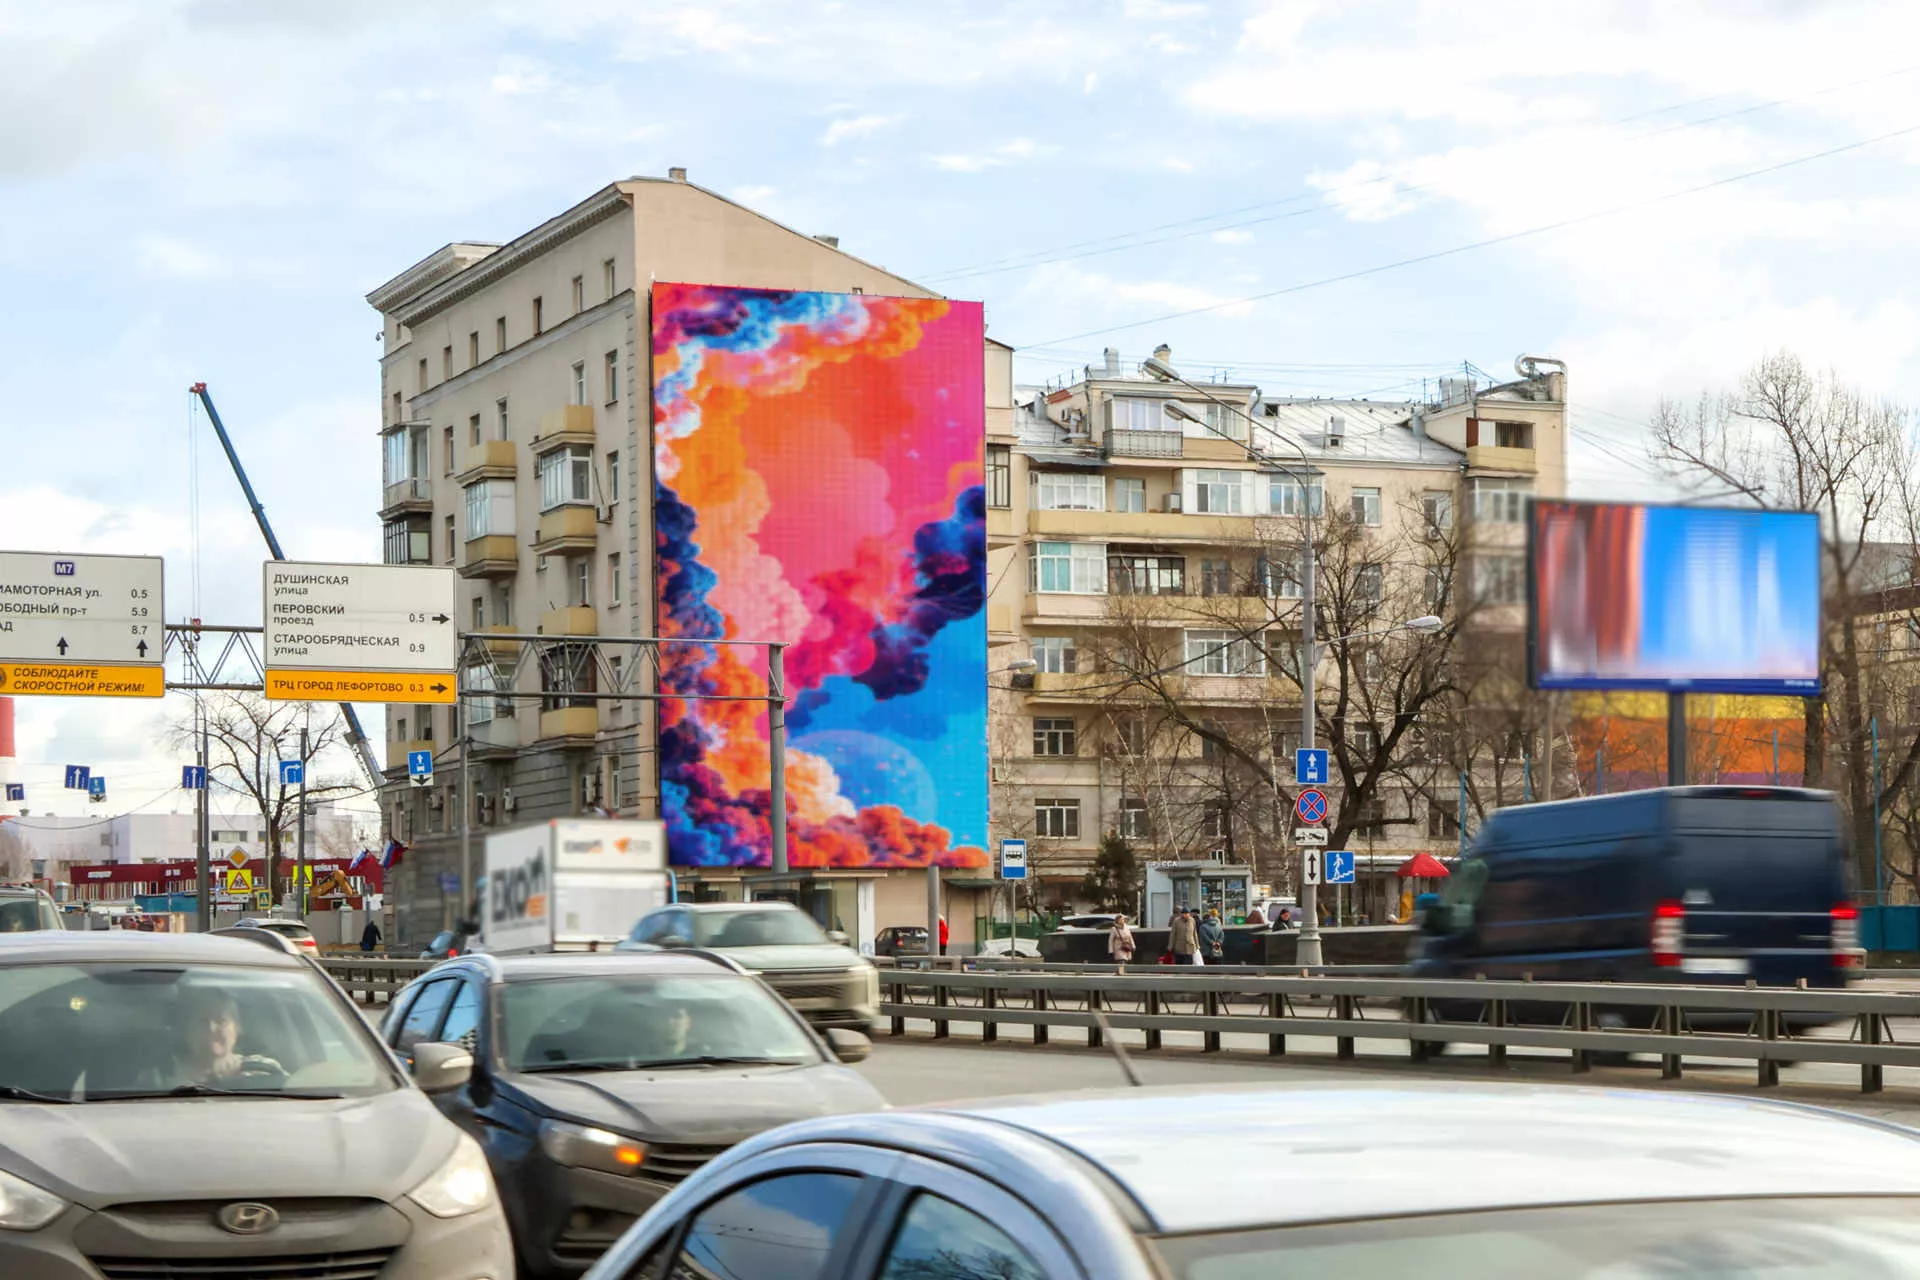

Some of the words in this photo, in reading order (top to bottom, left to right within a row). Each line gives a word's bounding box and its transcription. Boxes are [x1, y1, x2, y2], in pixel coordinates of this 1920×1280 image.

[273, 574, 349, 585] ДУШИНСКАЯ
[85, 588, 102, 598] ул.
[131, 588, 148, 599] 0.5
[274, 586, 308, 596] улица
[63, 607, 87, 616] пр-т
[131, 607, 148, 617] 5.9
[273, 603, 345, 615] ПЕРОВСКИЙ
[273, 616, 314, 626] проезд
[409, 613, 425, 623] 0.5
[131, 625, 147, 635] 8.7
[273, 634, 400, 646] СТАРООБРЯДЧЕСКАЯ
[273, 646, 308, 656] улица
[409, 643, 425, 653] 0.9
[14, 667, 99, 679] СОБЛЮДАЙТЕ
[14, 680, 95, 691] СКОРОСТНОЙ
[98, 682, 145, 692] РЕЖИМ!
[273, 680, 294, 690] ТРЦ
[297, 681, 333, 691] ГОРОД
[336, 681, 403, 692] ЛЕФОРТОВО
